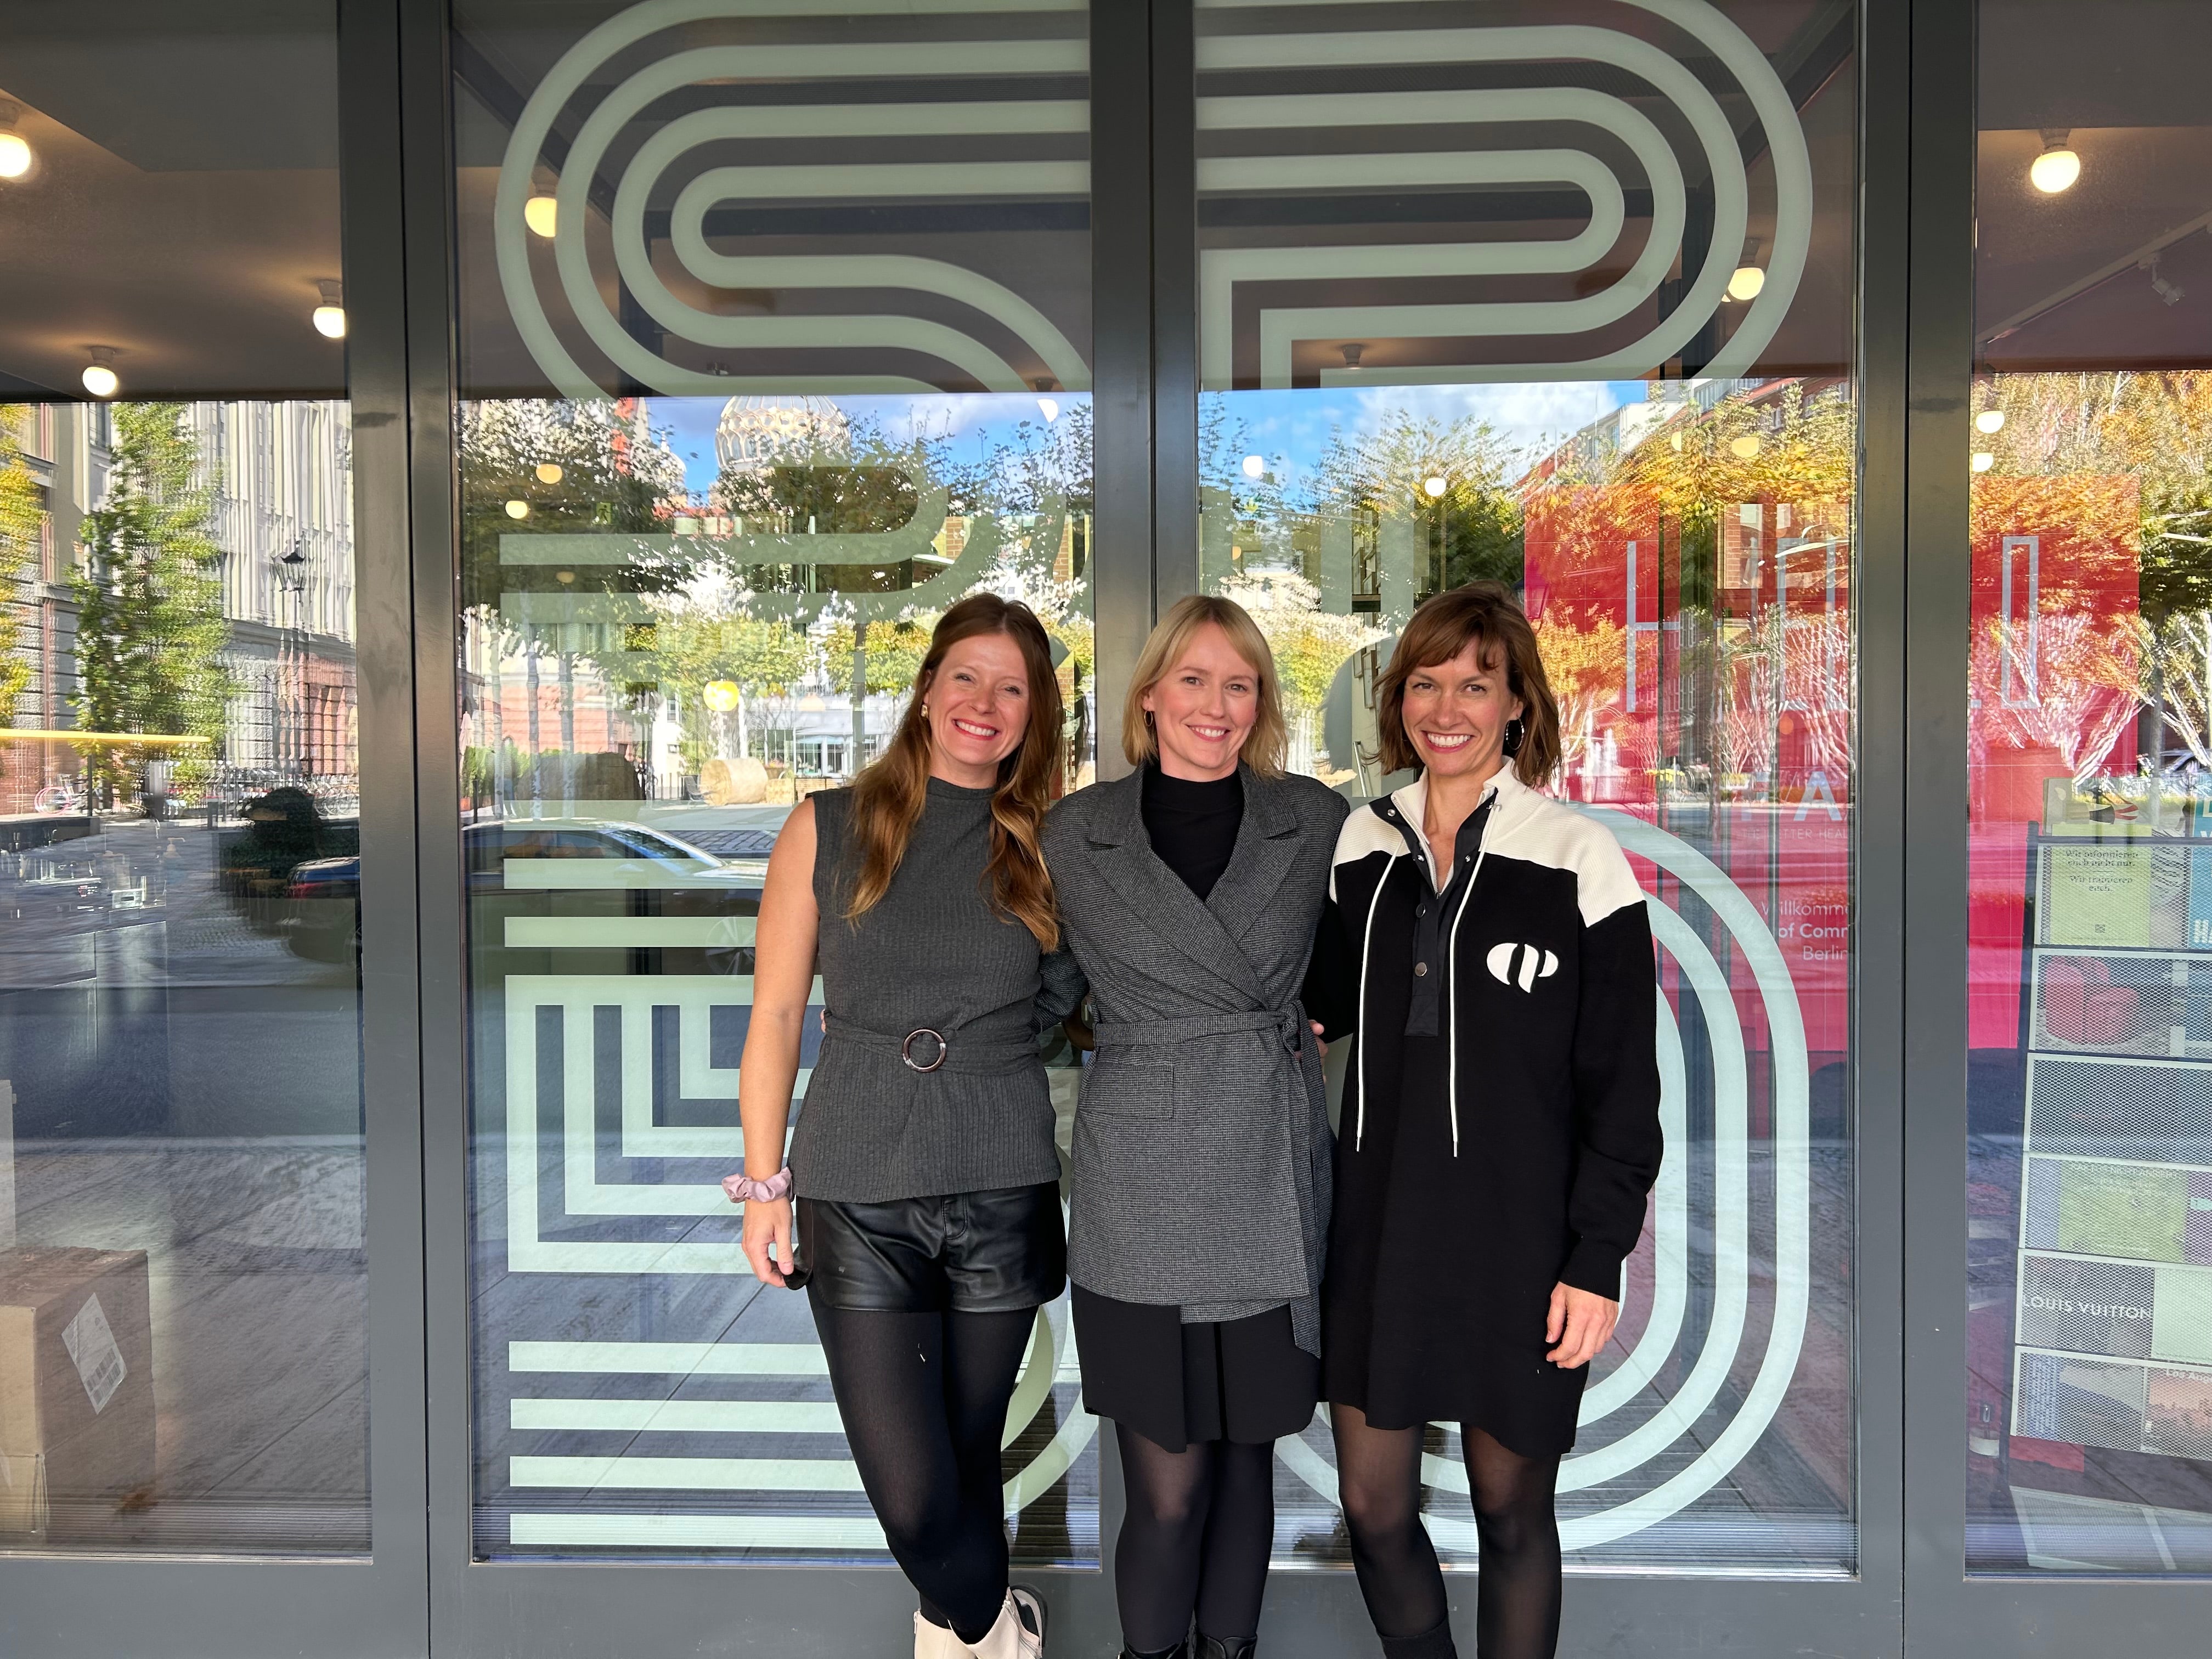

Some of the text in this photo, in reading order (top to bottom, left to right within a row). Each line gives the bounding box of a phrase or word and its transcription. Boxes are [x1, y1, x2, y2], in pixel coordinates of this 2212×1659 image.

[1778, 922, 1795, 938] of
[2023, 1295, 2152, 1320] LOUIS VUITTON
[2166, 1368, 2212, 1385] Los Ang
